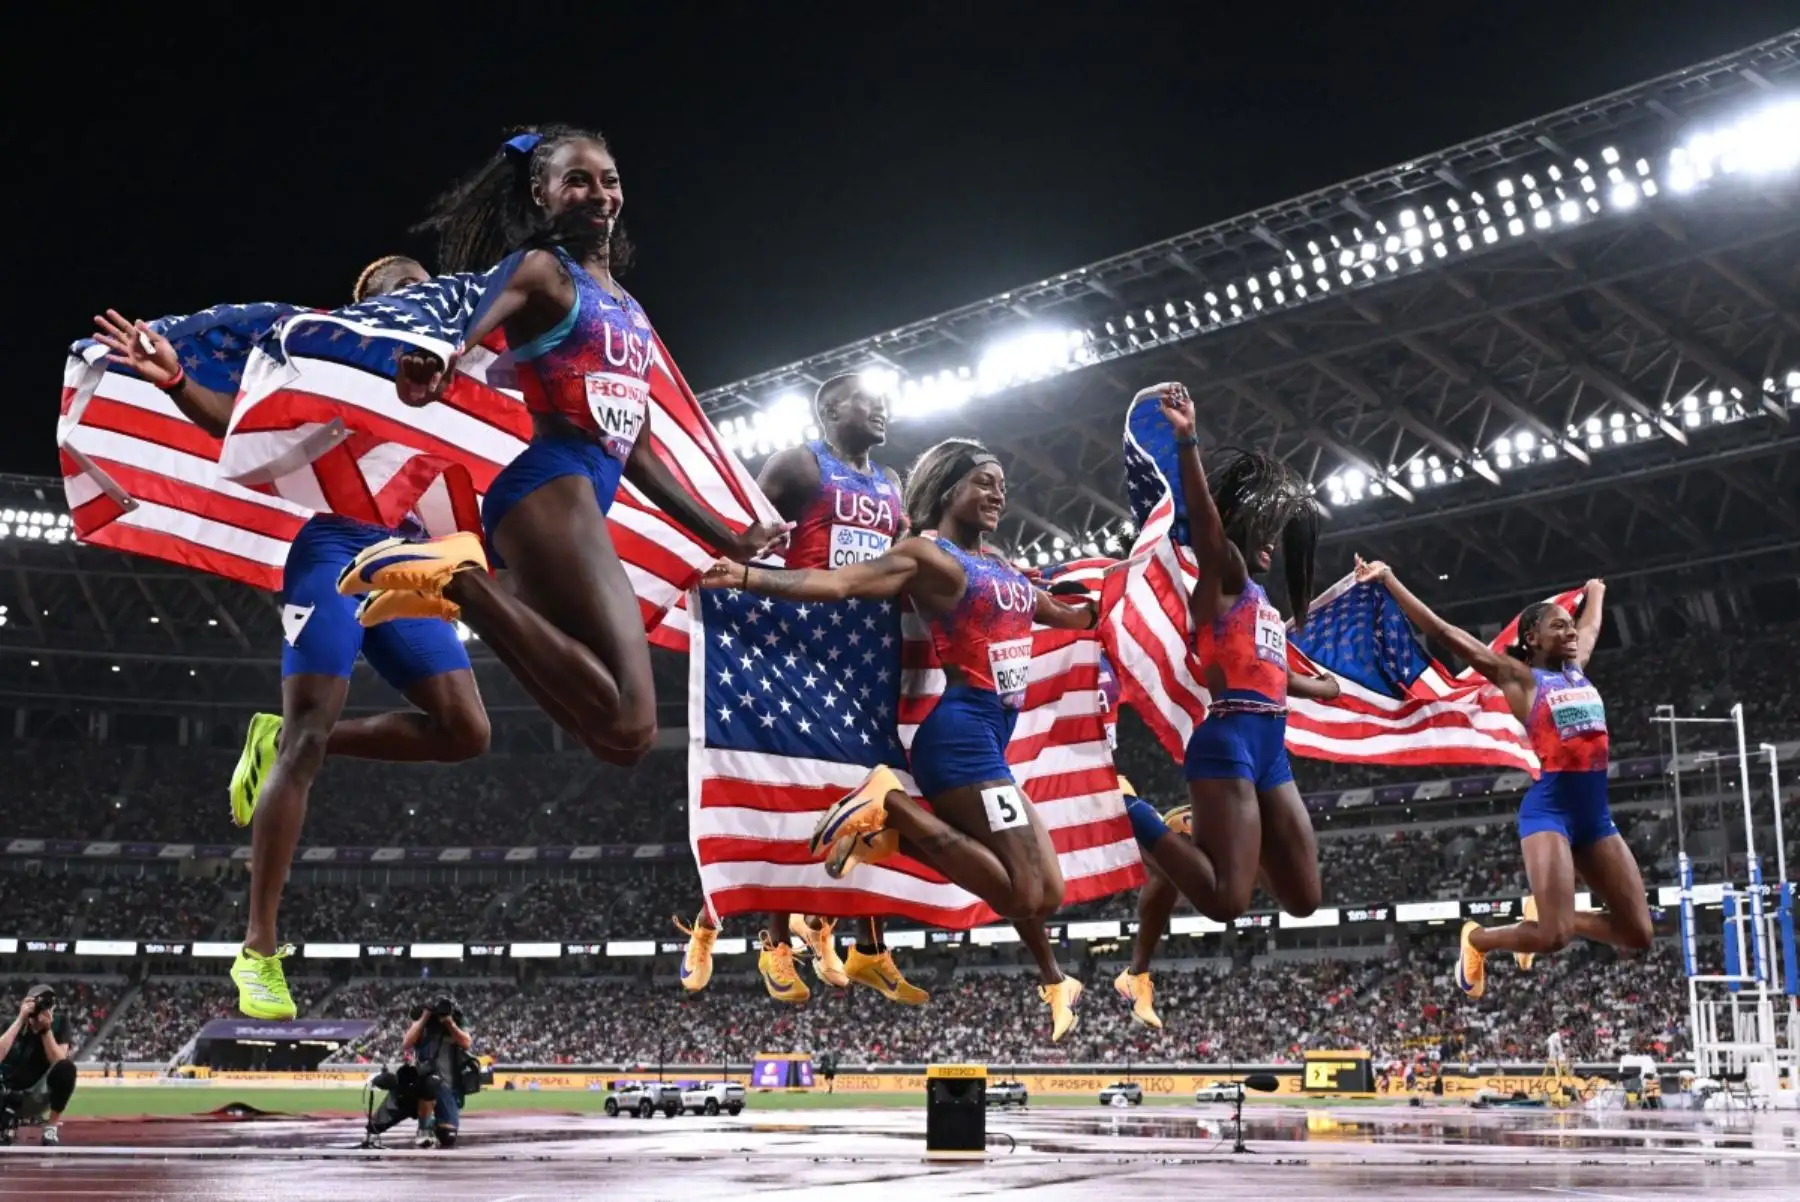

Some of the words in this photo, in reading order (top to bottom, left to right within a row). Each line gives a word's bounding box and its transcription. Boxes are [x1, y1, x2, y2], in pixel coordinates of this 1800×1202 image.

[604, 321, 655, 377] USA
[836, 488, 893, 534] USA
[853, 530, 888, 551] TDK
[992, 578, 1037, 613] USA
[997, 795, 1017, 823] 5
[836, 1076, 880, 1089] SEIKO
[938, 1067, 977, 1077] SEIKO
[1050, 1079, 1103, 1089] PROSPEX
